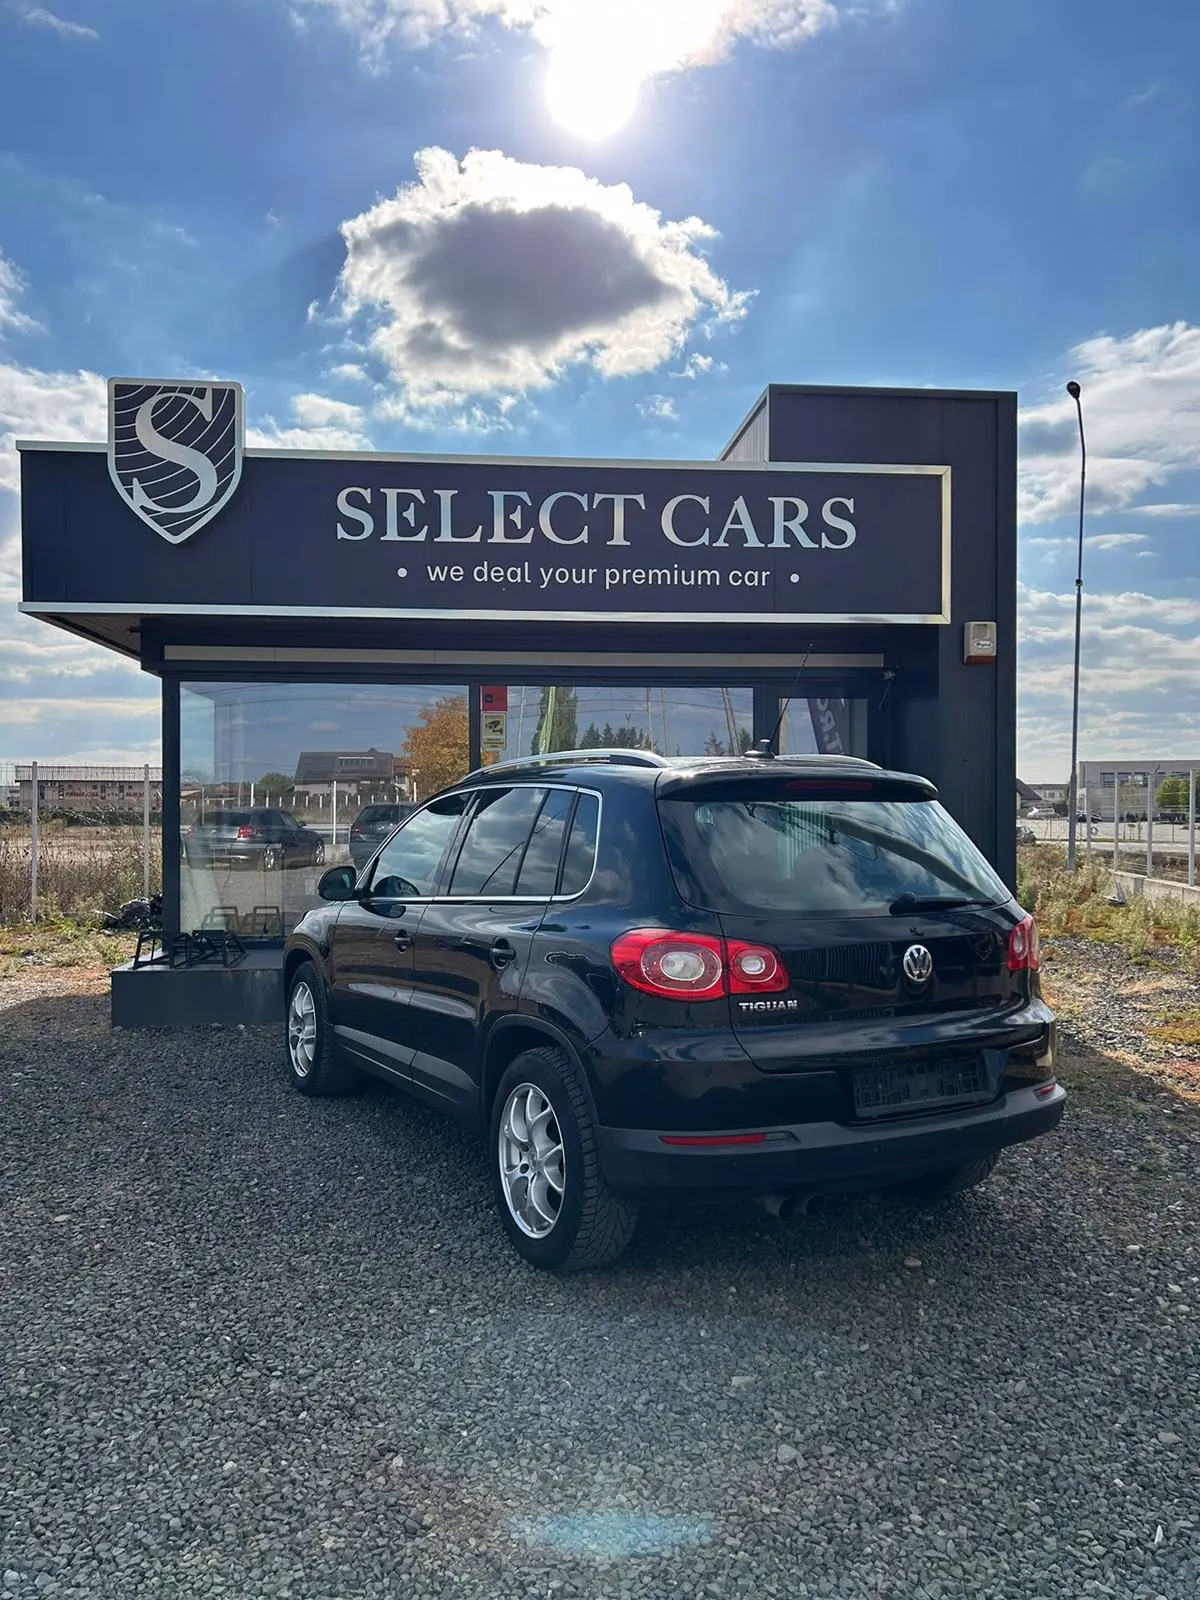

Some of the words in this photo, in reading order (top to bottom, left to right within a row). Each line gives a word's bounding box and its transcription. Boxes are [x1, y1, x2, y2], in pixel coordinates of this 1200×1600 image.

[133, 386, 217, 514] S
[337, 487, 645, 545] SELECT
[662, 495, 856, 549] CARS
[427, 566, 463, 581] we
[474, 561, 531, 583] deal
[540, 568, 597, 588] your
[606, 564, 719, 589] premium
[729, 571, 770, 586] car
[739, 1000, 797, 1012] TIGUAN
